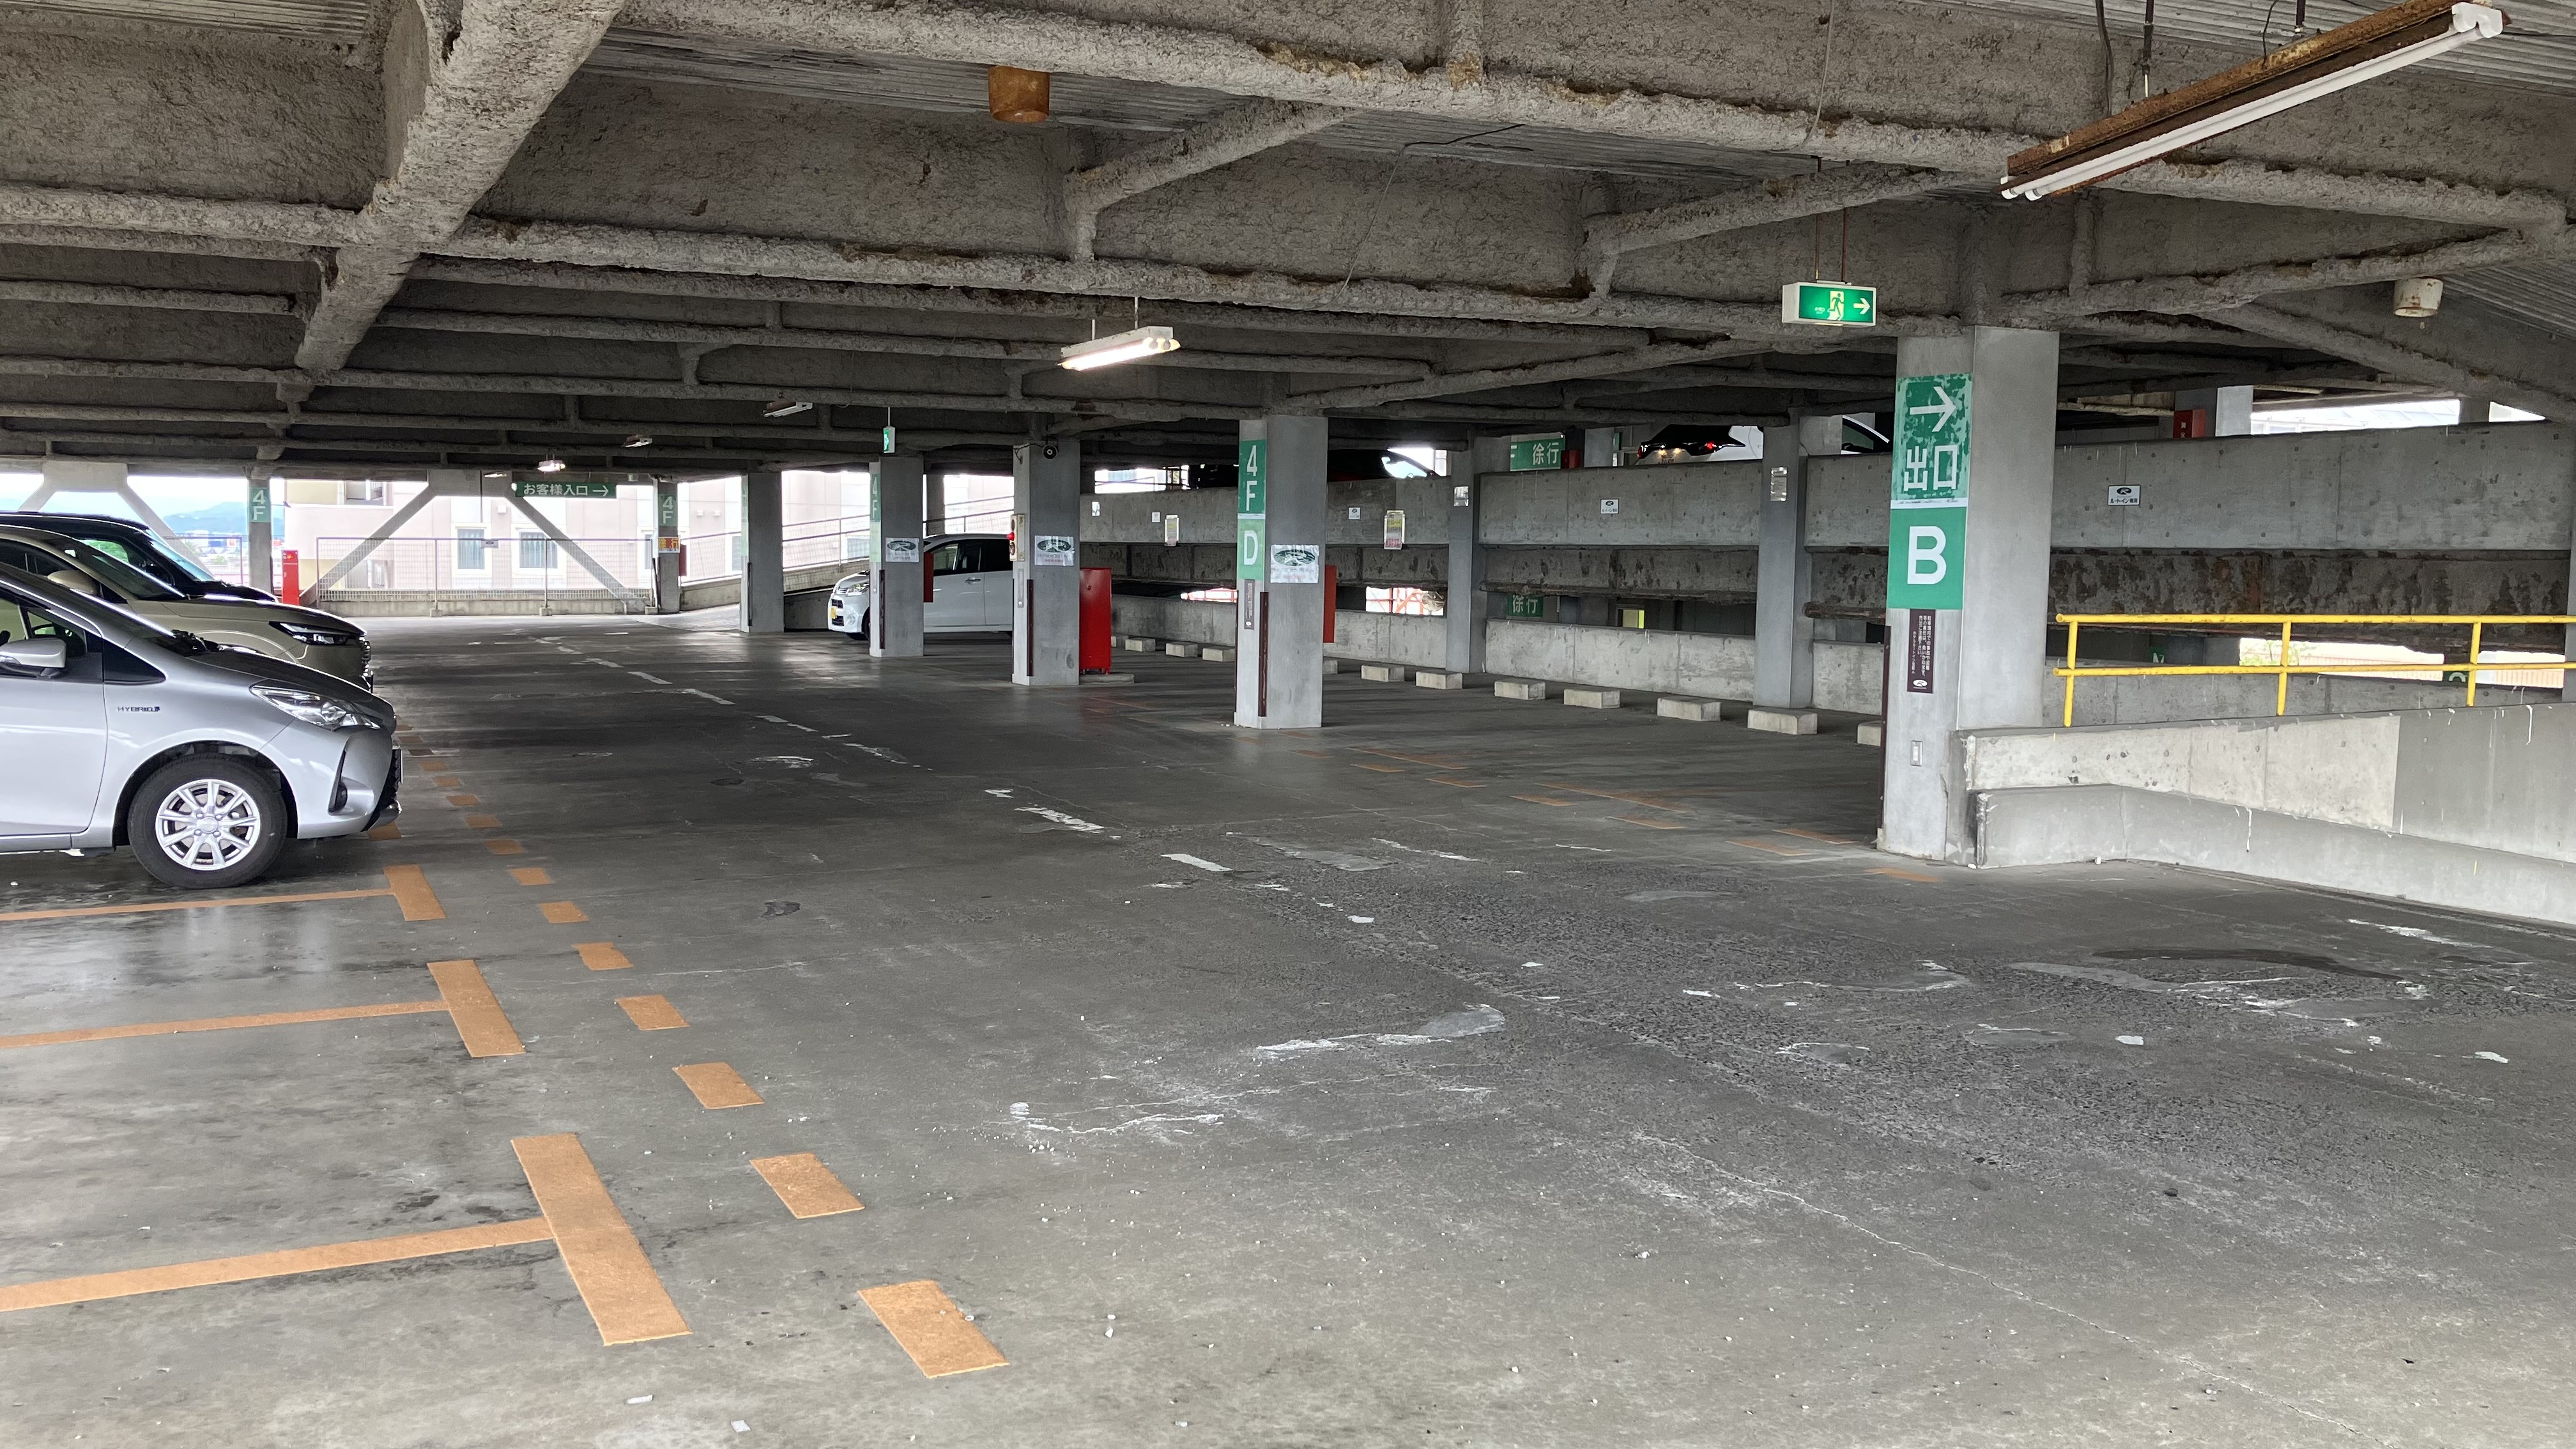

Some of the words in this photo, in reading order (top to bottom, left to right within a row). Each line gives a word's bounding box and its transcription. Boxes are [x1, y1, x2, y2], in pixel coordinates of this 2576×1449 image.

[1533, 442, 1559, 465] 徐行
[1903, 445, 1958, 491] 出口
[523, 484, 588, 496] お客様入口
[1246, 445, 1257, 510] 4F
[253, 489, 265, 520] 4F
[663, 496, 673, 524] 4F
[873, 477, 877, 519] 4F
[1243, 530, 1257, 565] D
[1907, 526, 1947, 585] B
[1513, 595, 1538, 613] 徐行
